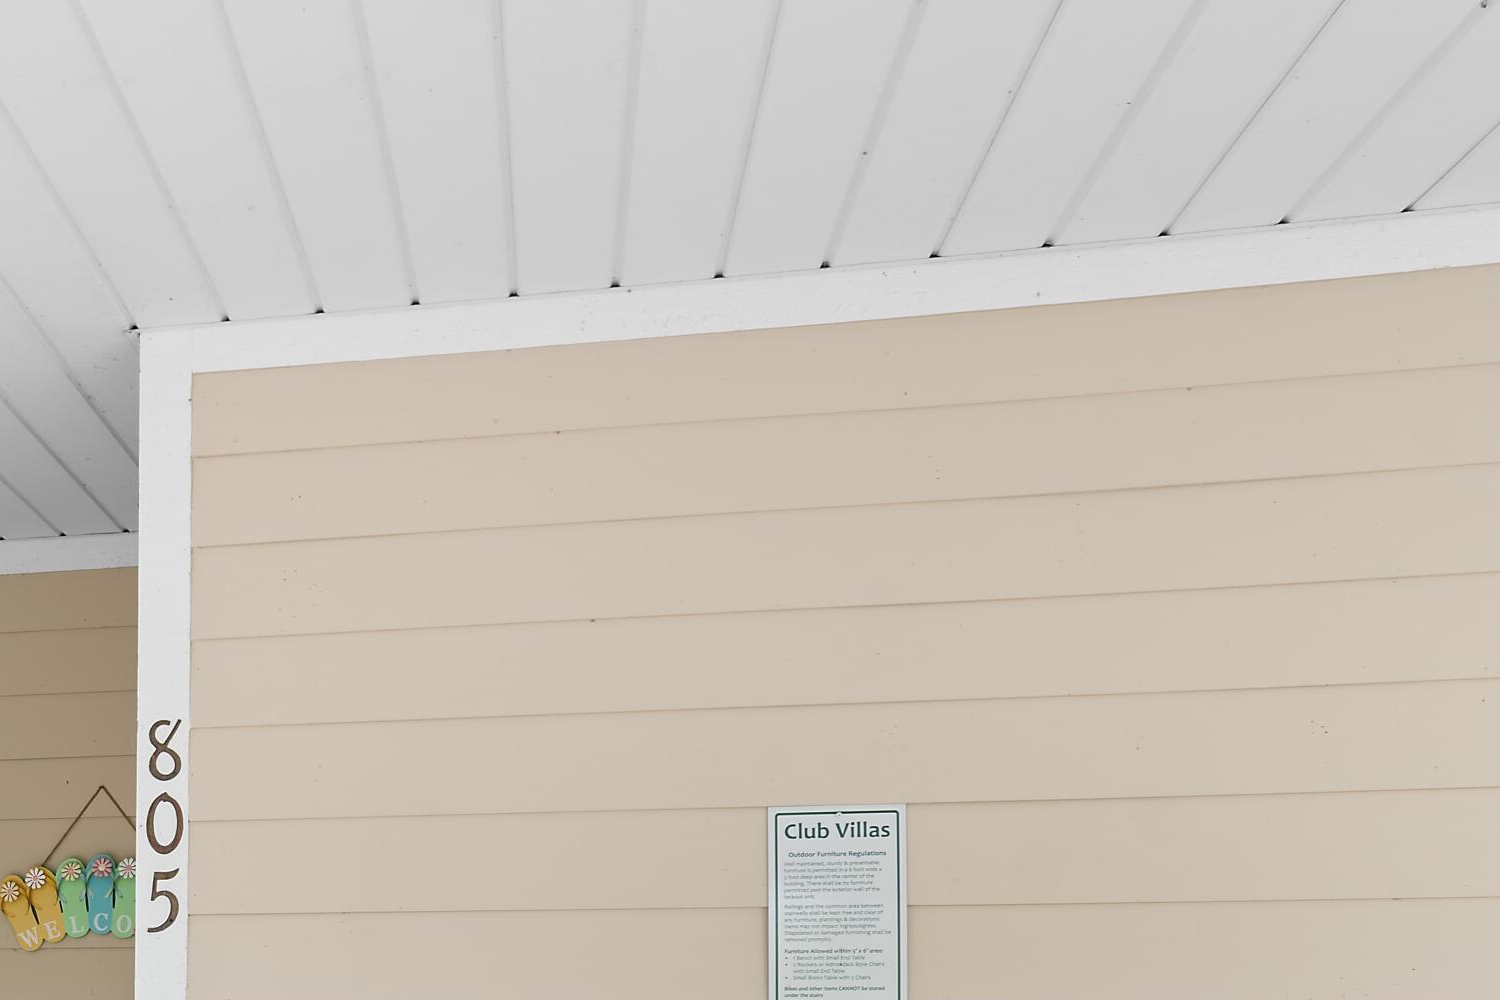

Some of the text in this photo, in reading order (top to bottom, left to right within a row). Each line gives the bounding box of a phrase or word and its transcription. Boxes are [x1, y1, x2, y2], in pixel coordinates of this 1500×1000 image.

[146, 718, 184, 933] 805
[784, 821, 891, 839] Club Villas
[18, 912, 132, 948] WELCO
